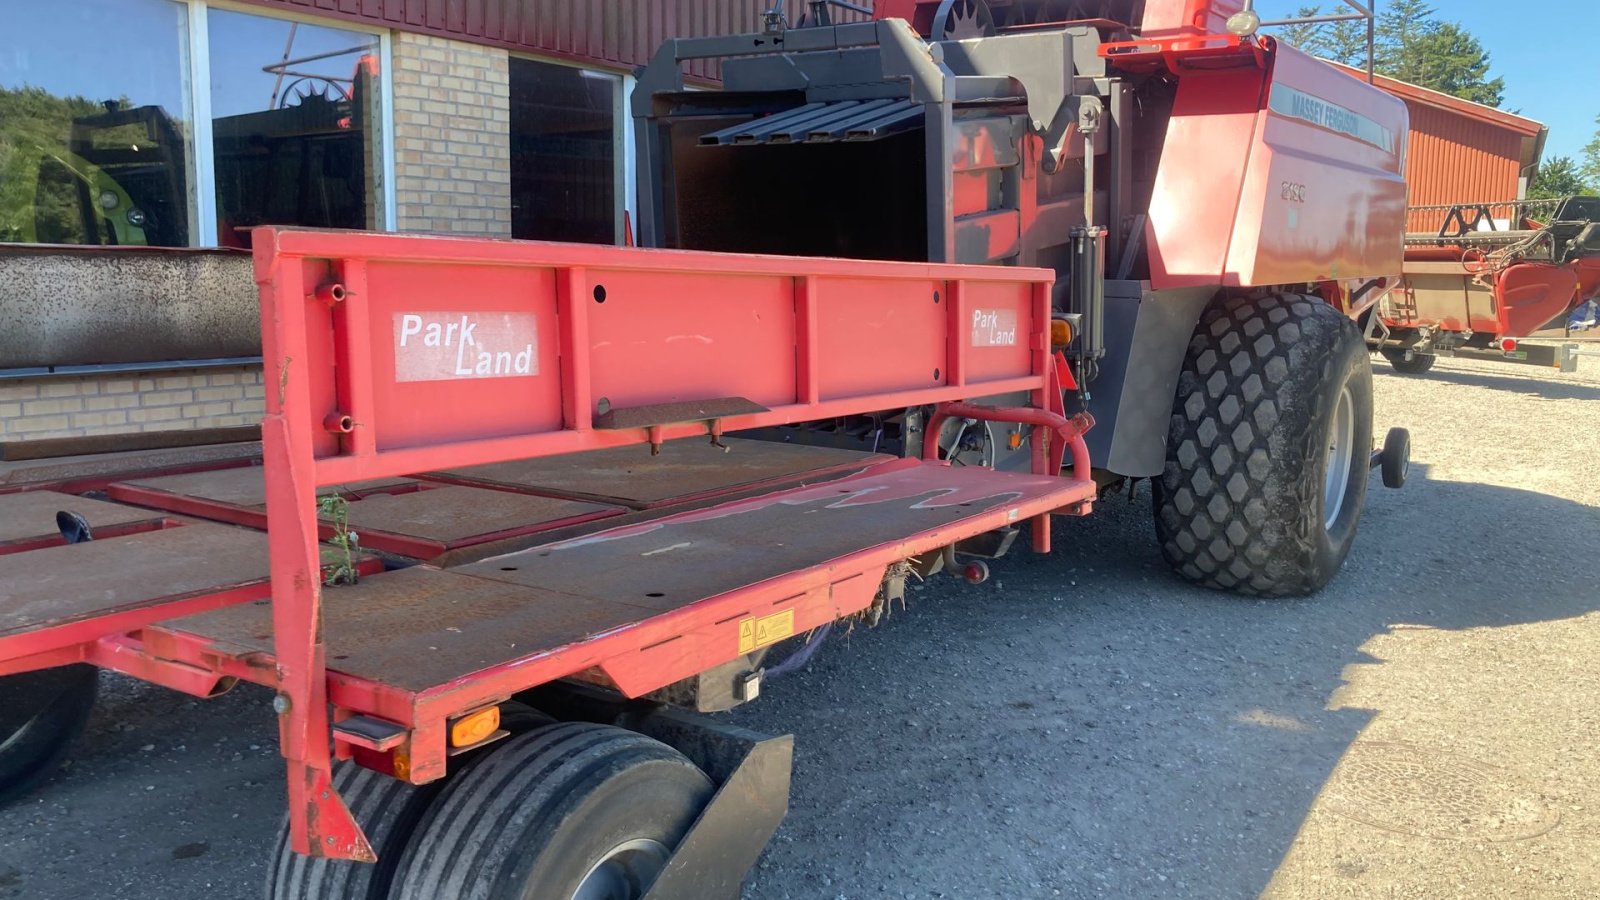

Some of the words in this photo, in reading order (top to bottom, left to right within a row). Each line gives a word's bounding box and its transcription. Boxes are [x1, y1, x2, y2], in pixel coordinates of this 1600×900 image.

[1292, 94, 1324, 124] MASSEY
[1325, 105, 1360, 136] FERGUSON
[400, 314, 476, 347] Park
[973, 309, 997, 328] Park
[990, 327, 1015, 344] Land
[456, 344, 532, 375] Land
